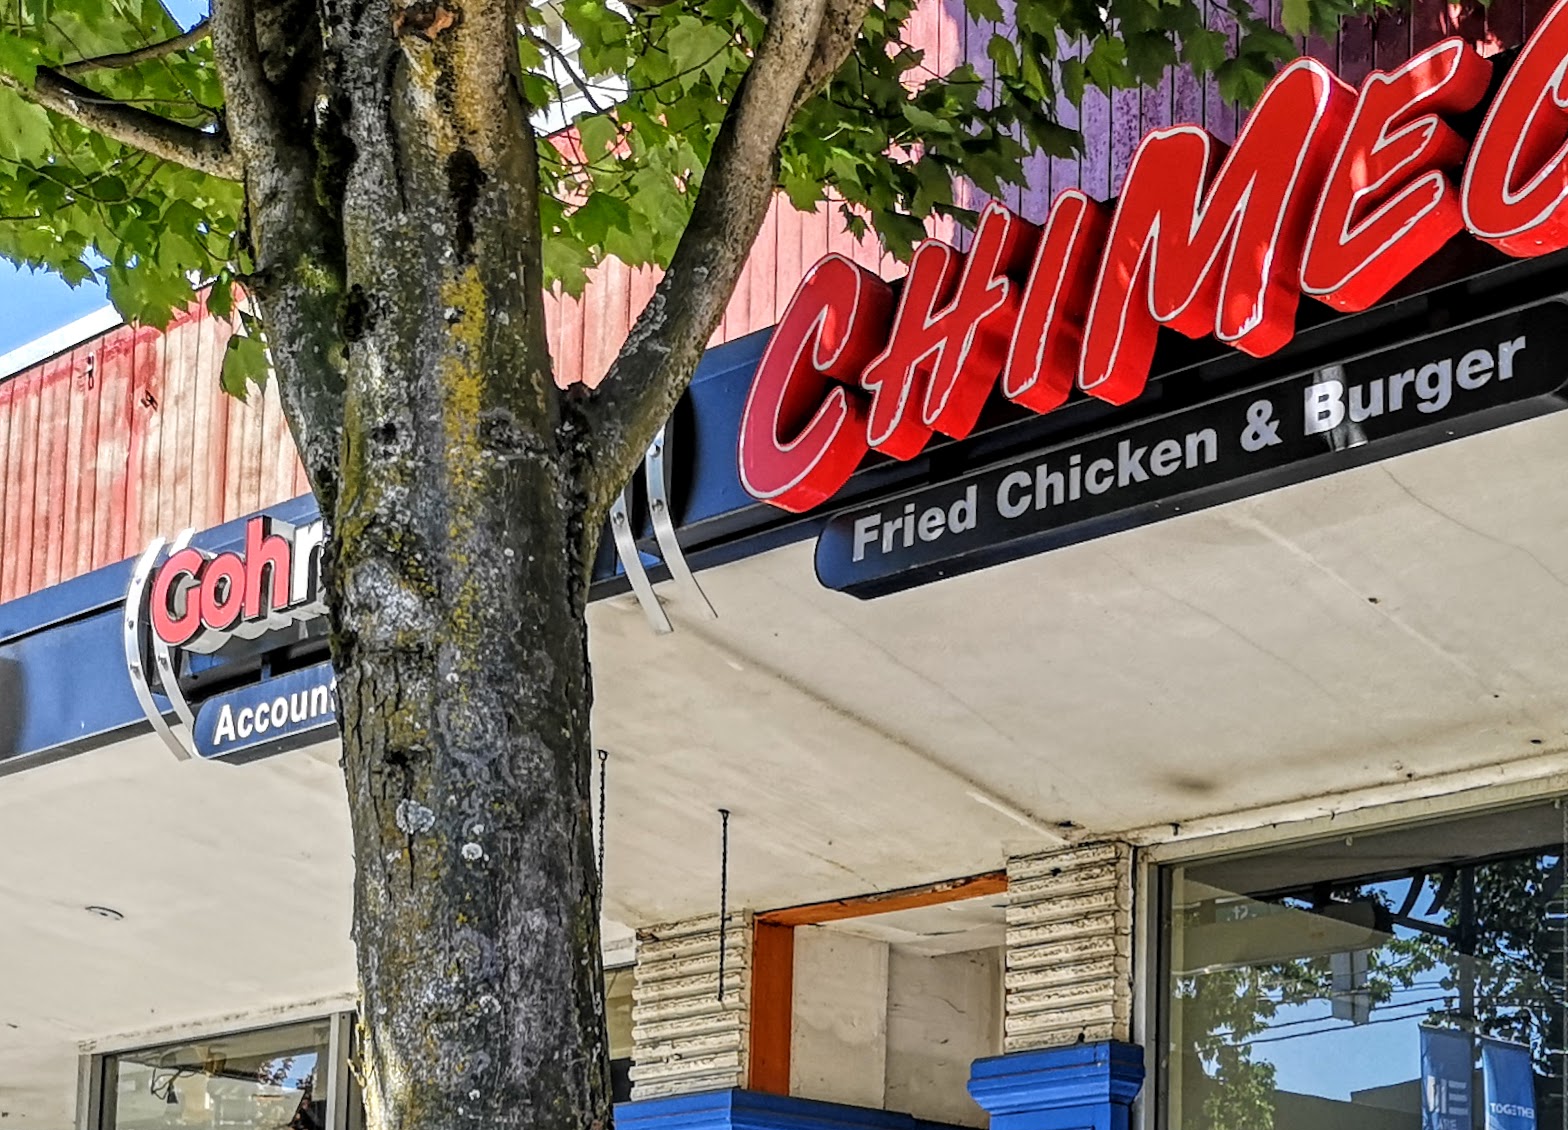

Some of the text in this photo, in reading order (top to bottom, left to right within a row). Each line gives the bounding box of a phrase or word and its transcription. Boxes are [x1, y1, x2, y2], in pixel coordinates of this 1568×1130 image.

[852, 334, 1527, 562] Fried Chicken & Burger
